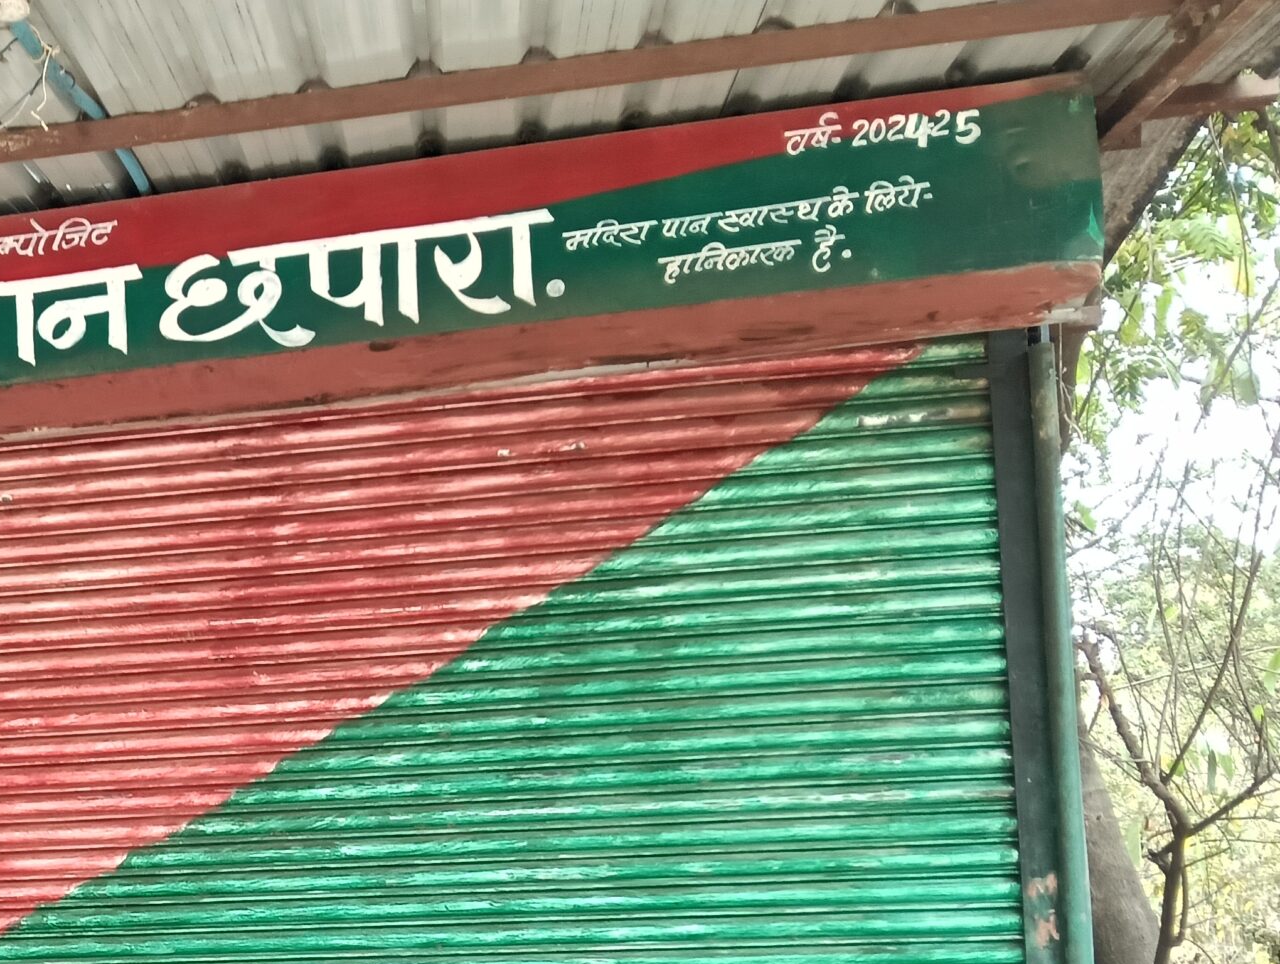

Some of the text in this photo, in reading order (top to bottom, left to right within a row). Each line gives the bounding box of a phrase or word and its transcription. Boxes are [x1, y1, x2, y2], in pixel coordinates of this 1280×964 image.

[561, 219, 659, 252] मदिरा
[661, 211, 723, 239] पान
[827, 184, 860, 219] के
[657, 239, 802, 285] हानिकारक
